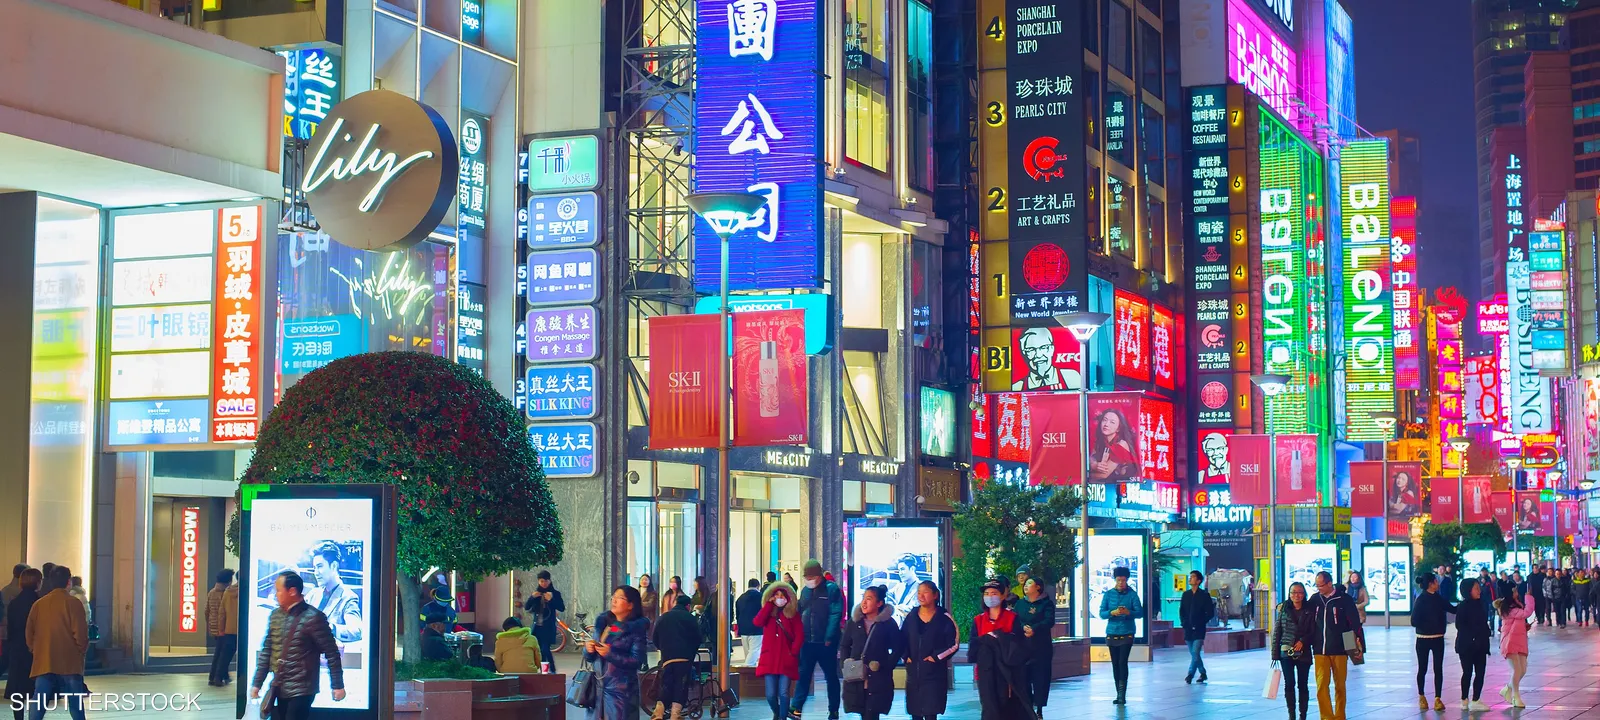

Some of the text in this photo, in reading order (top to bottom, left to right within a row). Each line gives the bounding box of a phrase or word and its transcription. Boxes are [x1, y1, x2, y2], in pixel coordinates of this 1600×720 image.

[1017, 5, 1057, 21] SHANGHAI
[985, 16, 1004, 40] 4
[1017, 21, 1062, 37] PORCELAIN
[1017, 40, 1038, 54] EXPO
[1015, 76, 1073, 98] 珍珠城
[1192, 94, 1215, 107] 观景
[986, 101, 1006, 126] 3
[1015, 102, 1067, 118] PEARLS CITY
[1192, 109, 1226, 121] 咖啡餐厅
[1232, 110, 1238, 123] 7
[1193, 123, 1218, 133] COFFEE
[1192, 134, 1226, 145] RESTAURANT
[561, 173, 591, 185] 小火锅
[1203, 179, 1218, 189] 中心
[1234, 176, 1241, 188] 6
[987, 187, 1006, 212] 2
[1016, 193, 1076, 212] 工艺礼品
[1506, 154, 1524, 262] 上海置地广场
[1017, 213, 1070, 227] ART & CRAFTS
[1198, 221, 1224, 235] 陶瓷
[1235, 229, 1242, 242] 5
[1195, 265, 1227, 274] SHANGHAI
[1195, 271, 1229, 281] PORCELAIN
[1235, 266, 1242, 278] 4
[992, 273, 1005, 297] 1
[1197, 299, 1228, 311] 珍珠城
[1236, 304, 1243, 316] 3
[1391, 270, 1412, 348] 中国联通
[1015, 311, 1029, 319] New
[1031, 310, 1050, 318] World
[1196, 312, 1229, 320] PEARLS CITY
[113, 312, 209, 338] 三叶眼镜
[534, 333, 590, 343] Congen Massage
[1237, 341, 1244, 354] 2
[988, 347, 1011, 371] B1
[1198, 353, 1230, 363] 工艺礼品
[530, 372, 591, 395] 真丝大王
[669, 371, 701, 388] SK-II
[217, 399, 255, 415] SALE
[530, 396, 590, 411] SILK KING
[532, 432, 592, 452] 真丝大王
[1042, 432, 1067, 444] SK-II
[560, 453, 590, 467] KING
[767, 450, 810, 467] ME&CITY
[862, 460, 899, 476] ME&CITY
[1240, 464, 1259, 473] SK-II
[1194, 505, 1253, 523] PEARL CITY
[182, 509, 198, 631] McDonald's
